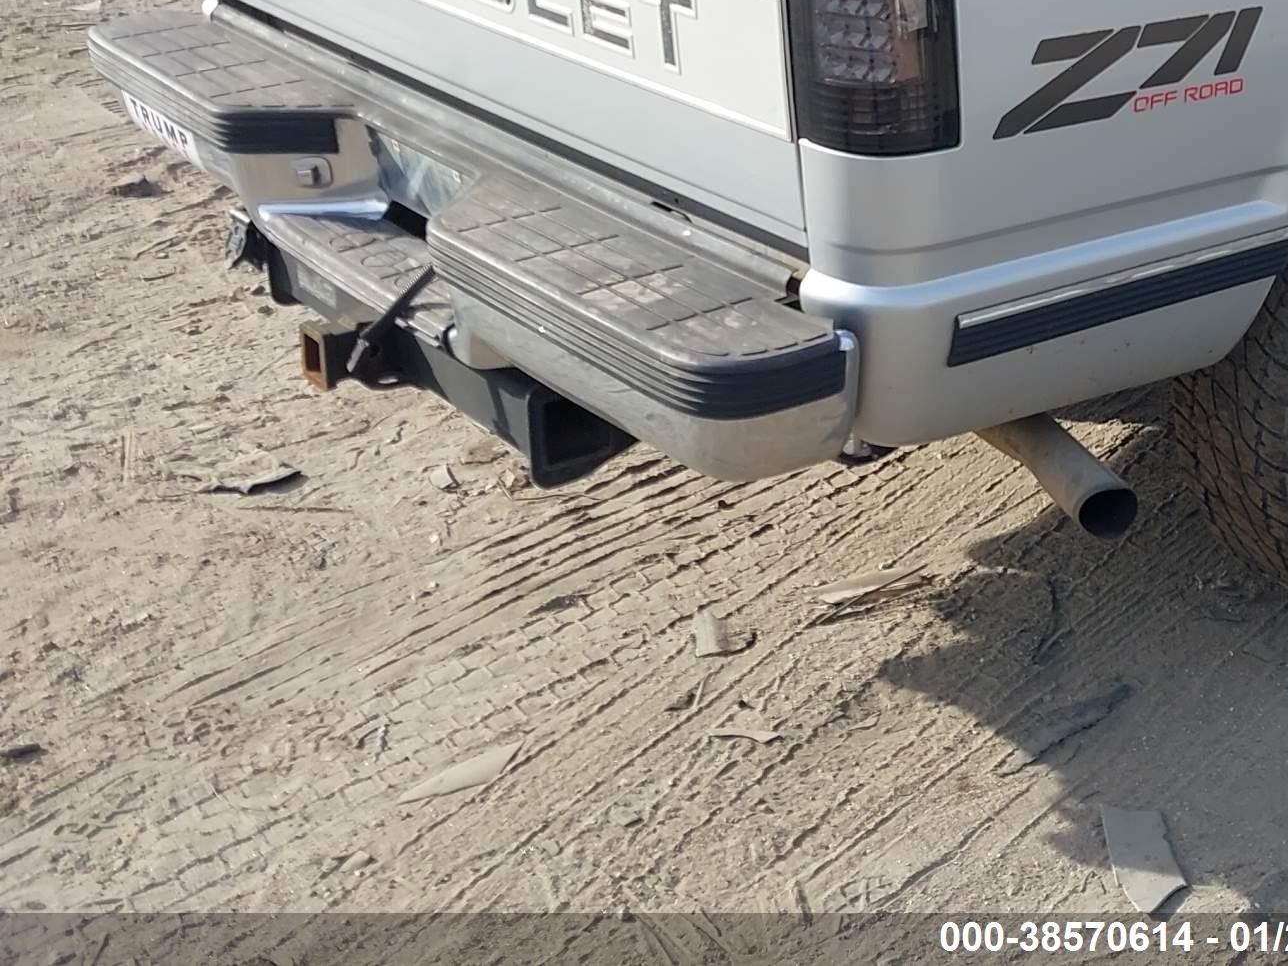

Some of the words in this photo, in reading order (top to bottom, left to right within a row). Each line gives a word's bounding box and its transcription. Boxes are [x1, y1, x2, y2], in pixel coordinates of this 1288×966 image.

[993, 6, 1263, 140] Z71
[1133, 90, 1178, 113] OFF
[1184, 79, 1244, 102] ROAD
[128, 97, 188, 149] TRUMP
